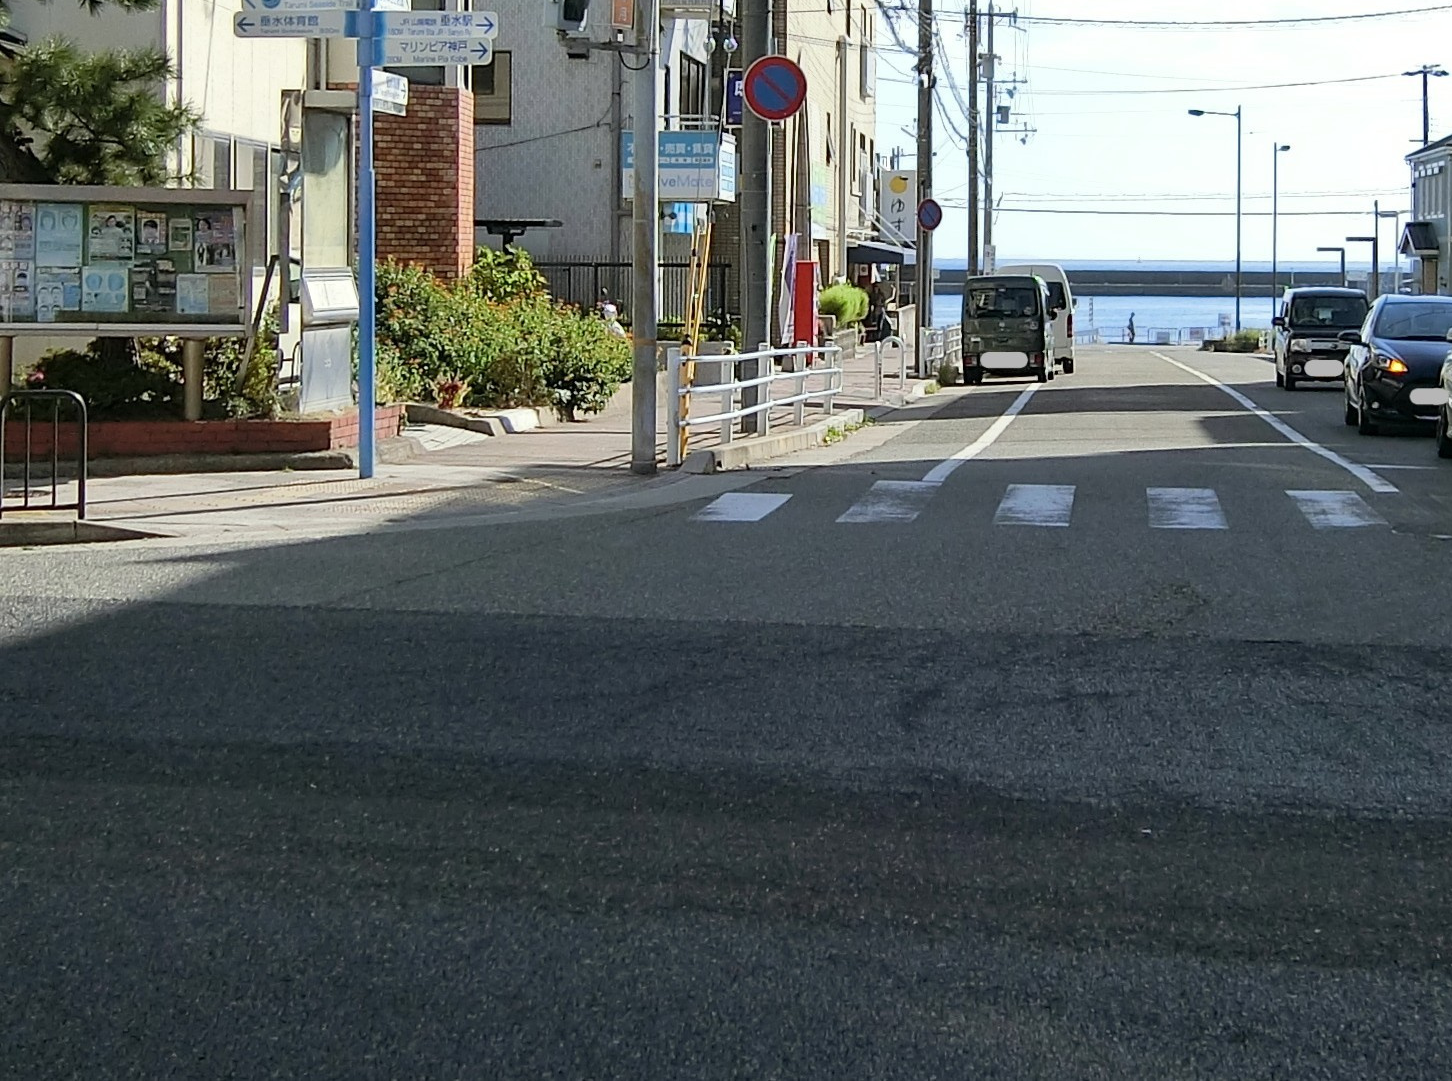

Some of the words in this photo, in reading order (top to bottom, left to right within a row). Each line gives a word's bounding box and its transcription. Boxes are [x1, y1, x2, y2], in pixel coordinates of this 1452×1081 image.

[260, 15, 319, 27] 垂水体育館
[440, 14, 473, 27] 垂水駅
[400, 40, 468, 53] マリンピア神戸
